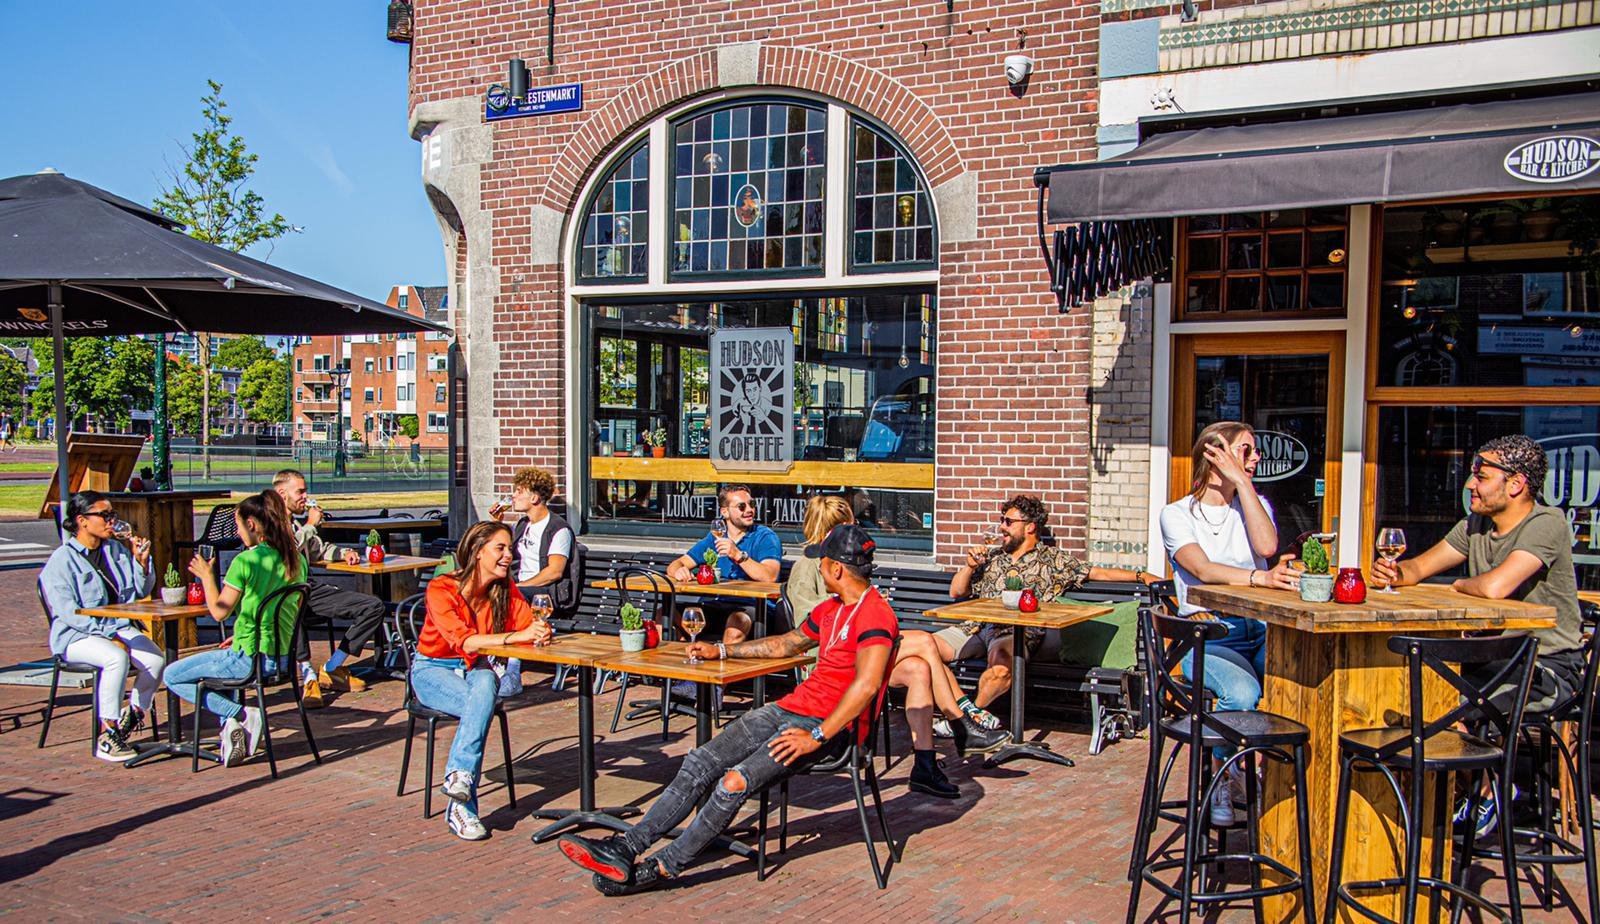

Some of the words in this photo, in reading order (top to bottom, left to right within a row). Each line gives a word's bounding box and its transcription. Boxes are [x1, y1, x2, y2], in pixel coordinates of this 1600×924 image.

[1521, 140, 1591, 164] HUDSON
[1520, 163, 1538, 176] BAR
[1540, 164, 1548, 177] &
[1550, 161, 1587, 177] KITCHEN
[720, 340, 785, 367] HUDSON
[719, 436, 784, 462] COFFEE
[1256, 459, 1292, 476] KITCHEN
[666, 494, 705, 519] LUNCH
[773, 497, 807, 523] TAKE
